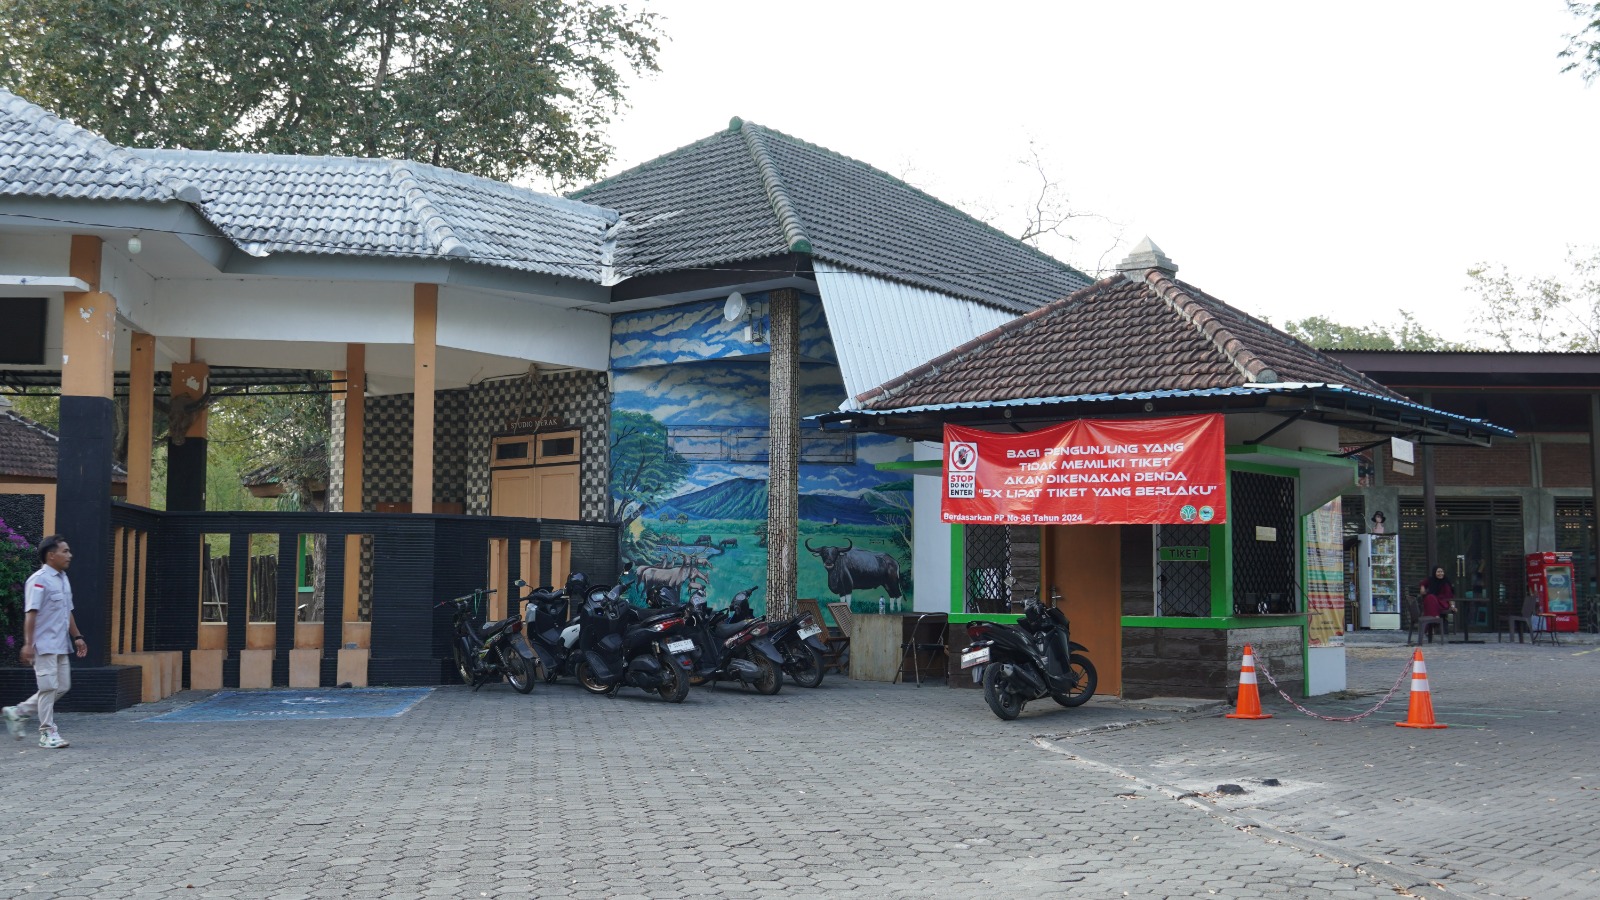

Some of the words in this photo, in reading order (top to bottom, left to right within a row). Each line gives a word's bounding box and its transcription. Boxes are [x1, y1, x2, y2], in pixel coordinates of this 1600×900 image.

[1006, 449, 1040, 458] BAGI
[1044, 444, 1139, 457] PENGUNJUNG
[1142, 442, 1184, 453] YANG
[1019, 460, 1058, 471] TIDAK
[1061, 458, 1125, 470] MEMILIKI
[1129, 457, 1172, 468] TIKET
[1004, 475, 1044, 485] AKAN
[1046, 472, 1131, 484] DIKENAKAN
[1134, 471, 1188, 482] DENDA
[1006, 488, 1043, 499] LIPAT
[1046, 487, 1088, 498] TIKET
[1091, 486, 1132, 497] YANG
[1135, 485, 1217, 497] BERLAKU"
[943, 512, 992, 522] Berdasarkan
[994, 513, 1005, 522] PP
[1020, 513, 1031, 522] 36
[1033, 513, 1060, 522] Tahun
[1061, 513, 1083, 522] 2024
[1169, 548, 1199, 559] TIKET
